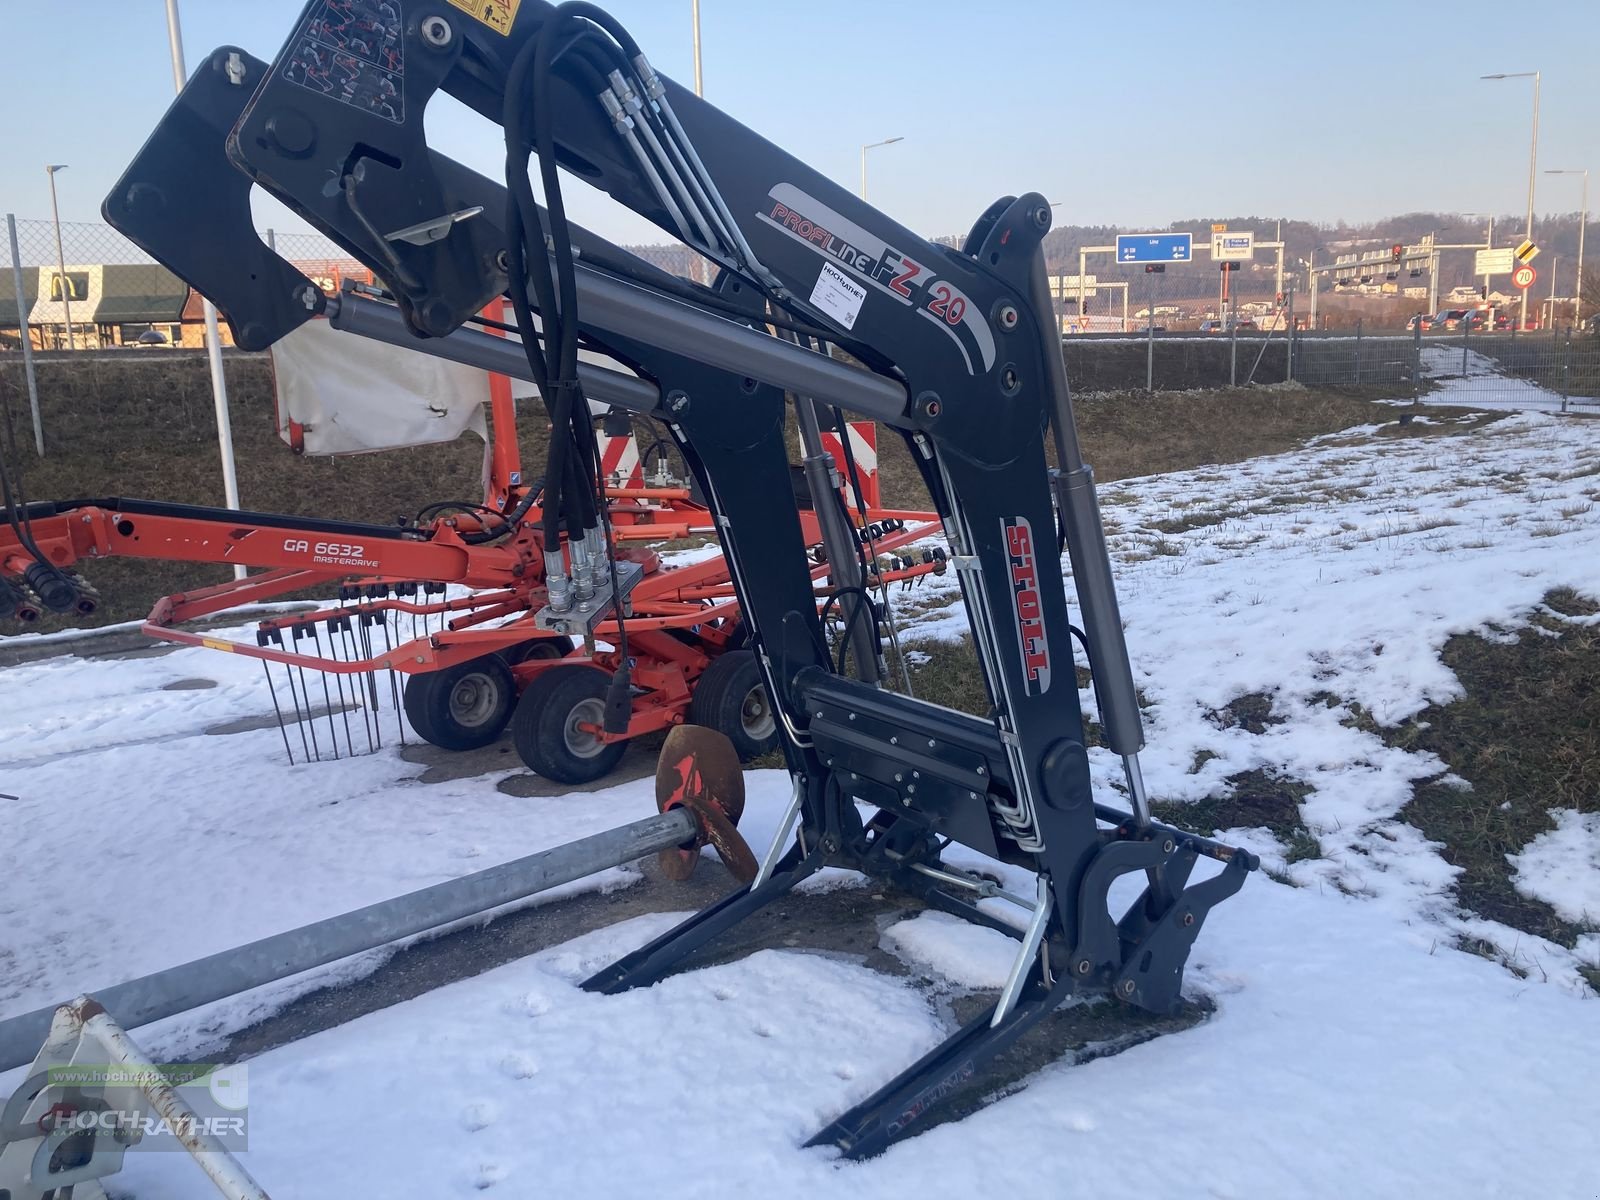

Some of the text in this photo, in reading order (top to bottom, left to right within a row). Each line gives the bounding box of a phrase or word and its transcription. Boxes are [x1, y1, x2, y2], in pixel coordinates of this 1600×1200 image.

[823, 266, 864, 300] HOCHRATHER
[870, 247, 921, 298] FZ
[928, 286, 966, 325] 20
[1519, 271, 1531, 282] 70
[283, 539, 364, 558] GA 6632
[313, 555, 379, 567] MASTERDRIVE
[1006, 525, 1049, 681] STOLL
